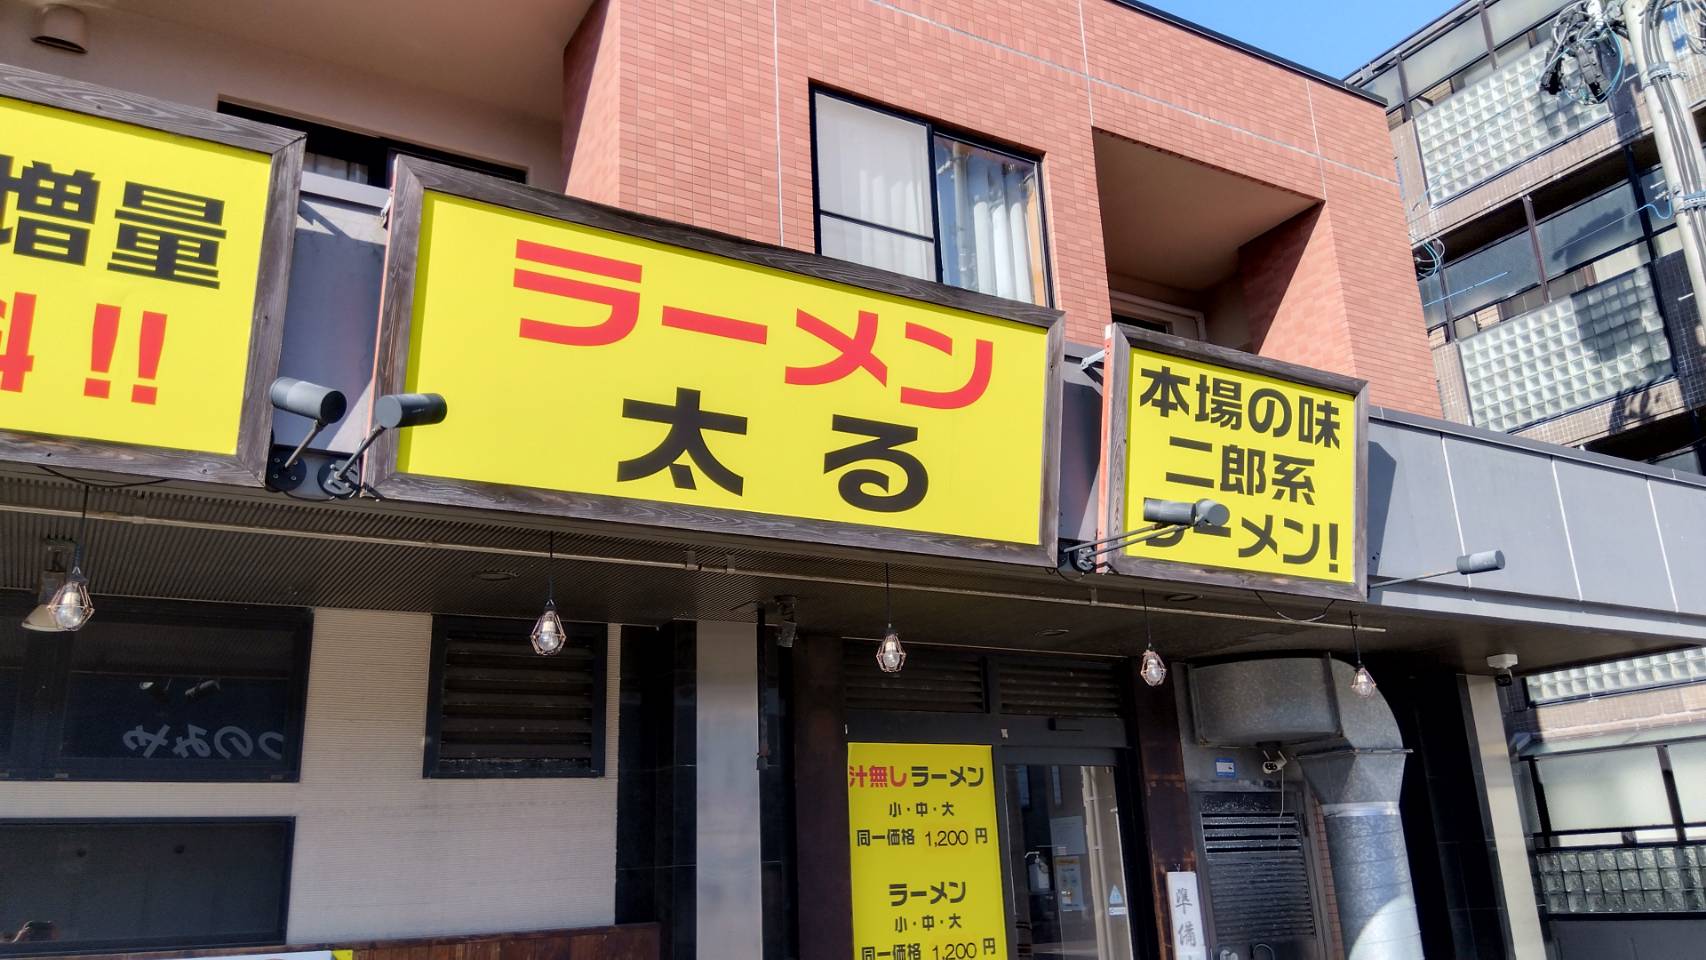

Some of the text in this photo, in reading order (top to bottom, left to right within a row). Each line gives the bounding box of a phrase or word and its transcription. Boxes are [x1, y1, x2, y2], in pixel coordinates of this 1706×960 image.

[513, 239, 993, 410] ラーメン
[1139, 365, 1341, 449] 本場の味
[617, 387, 929, 513] 太る
[1165, 435, 1315, 505] 二郎系
[849, 765, 984, 788] 汁無しラーメン
[856, 828, 988, 847] 同一価格 1,200 円
[889, 881, 966, 907] ラーメン
[1175, 887, 1199, 960] 準備
[983, 938, 996, 956] 円
